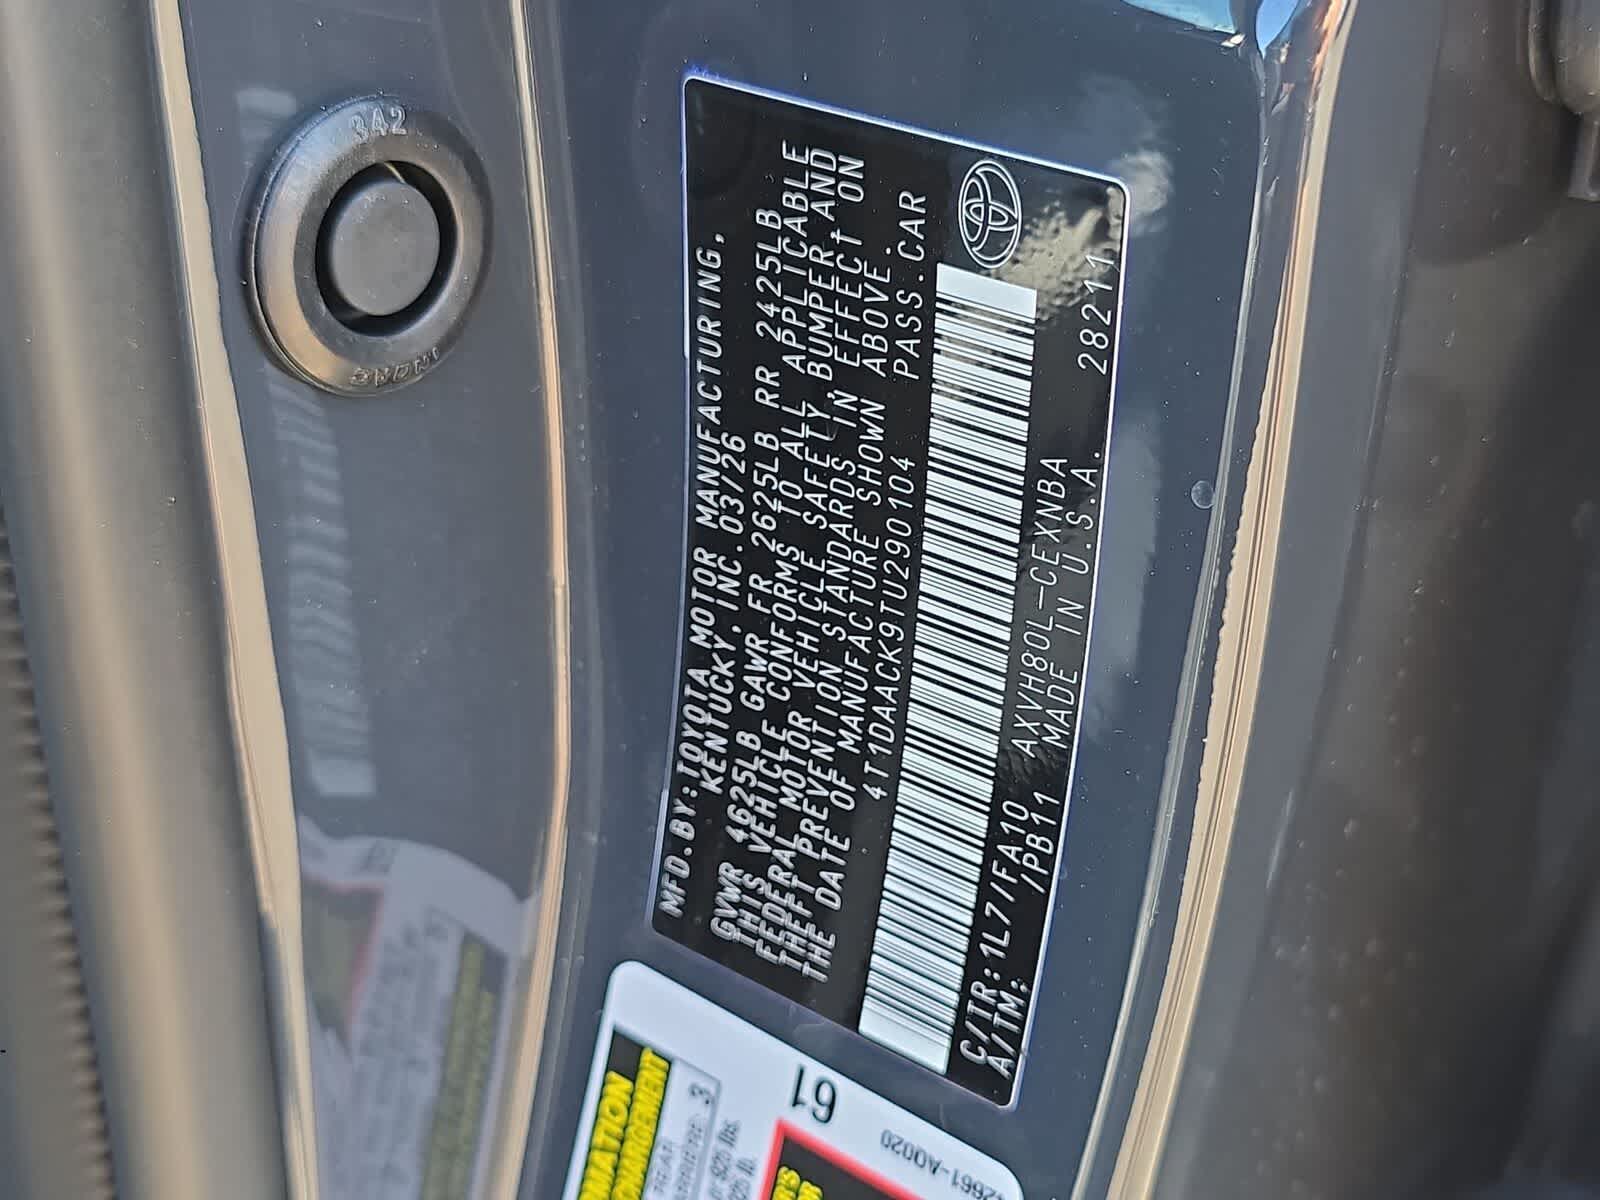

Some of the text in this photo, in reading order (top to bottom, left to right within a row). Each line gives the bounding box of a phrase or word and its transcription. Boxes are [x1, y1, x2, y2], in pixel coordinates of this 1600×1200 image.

[809, 147, 838, 222] AND
[1077, 253, 1115, 376] 28211
[695, 233, 725, 529] MANUFACTURING,
[710, 208, 782, 941] GVWR 4625LB GAWR FR 2625LB RR 2425LB
[731, 139, 810, 948] THIS VEHICLE CONFORMS TO ALL APPLICABLE
[778, 154, 865, 971] THEFT PREVENTION STANDARDS IN EFFECT ON
[1062, 451, 1101, 575] U.S.A.
[689, 546, 718, 650] MOTOR
[792, 549, 826, 689] VEHICLE
[801, 246, 891, 983] THE DATE OF MANUFACTURE SHOWN ABOVE.
[862, 455, 917, 801] 4T1DAACK9TU290104
[1055, 597, 1085, 636] IN
[779, 710, 813, 813] MOTOR
[1041, 661, 1079, 750] MADE
[755, 833, 801, 965] FEDERAL
[1020, 790, 1061, 894] /PB11
[790, 1063, 837, 1124] 61
